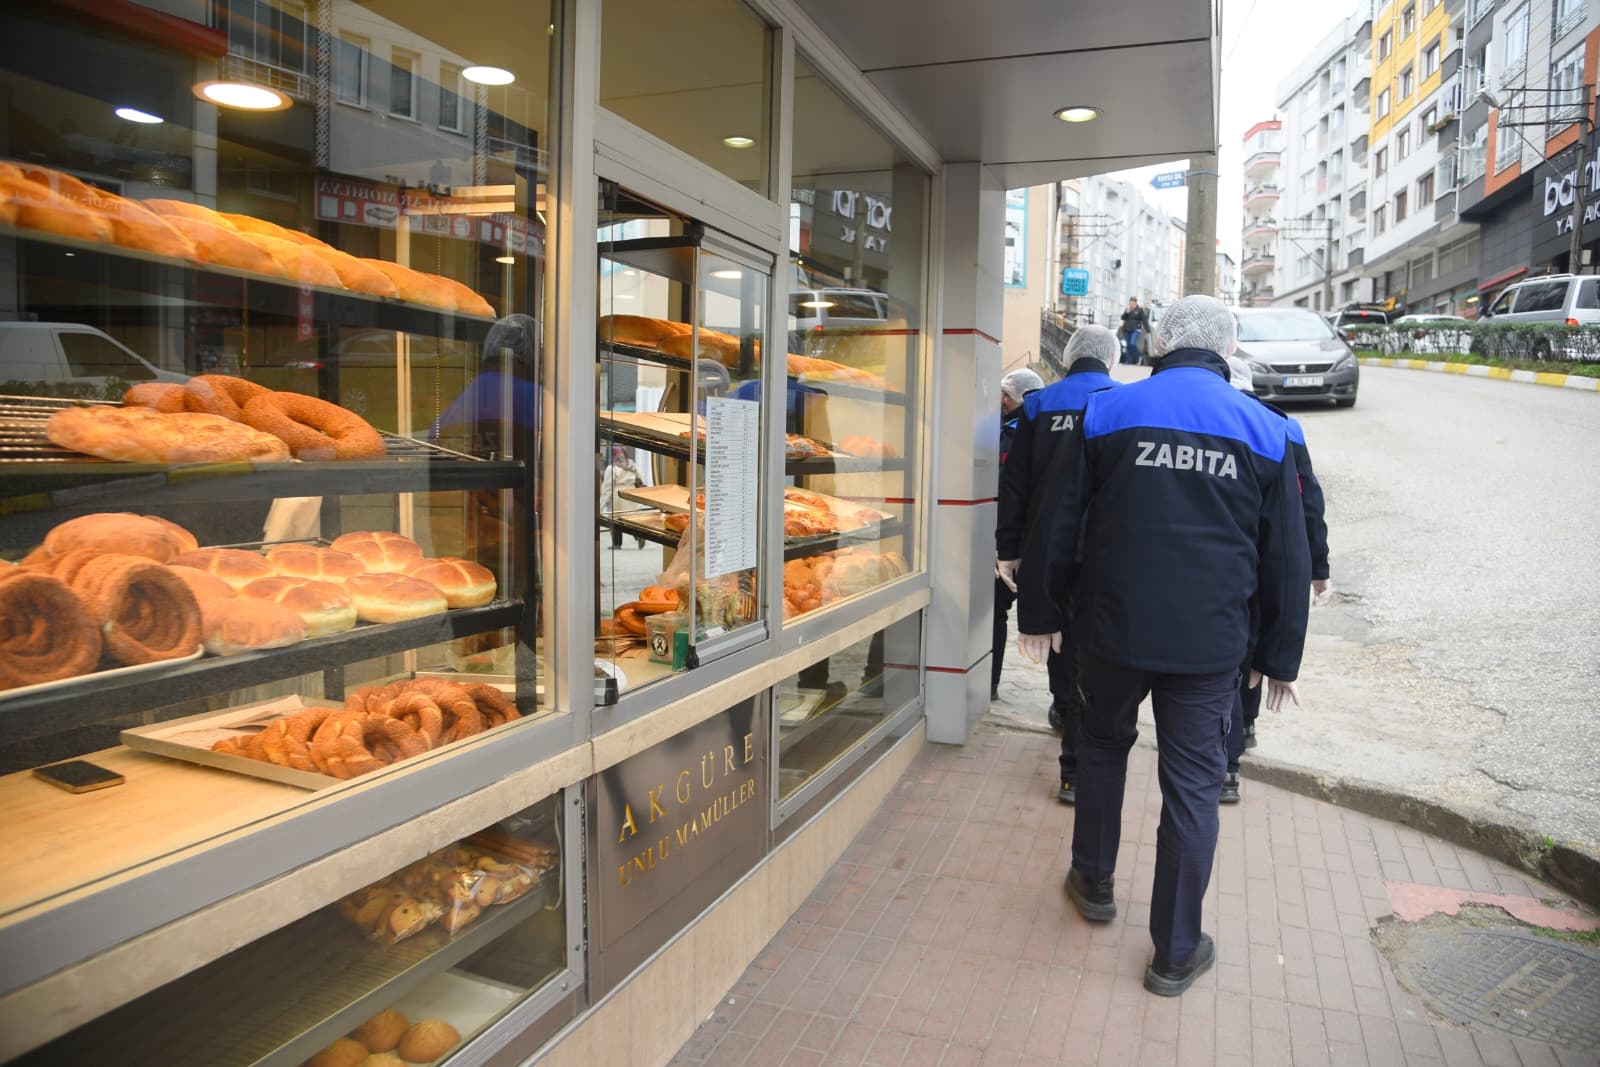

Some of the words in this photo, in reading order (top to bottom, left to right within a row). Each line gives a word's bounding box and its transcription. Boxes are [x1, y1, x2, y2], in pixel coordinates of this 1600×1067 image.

[1556, 200, 1600, 236] YAAK
[1050, 415, 1079, 432] ZA
[1135, 441, 1238, 480] ZABITA
[618, 732, 754, 843] AKGÜRE
[618, 835, 671, 888] UNLU
[676, 778, 756, 848] MAMÜLLER
